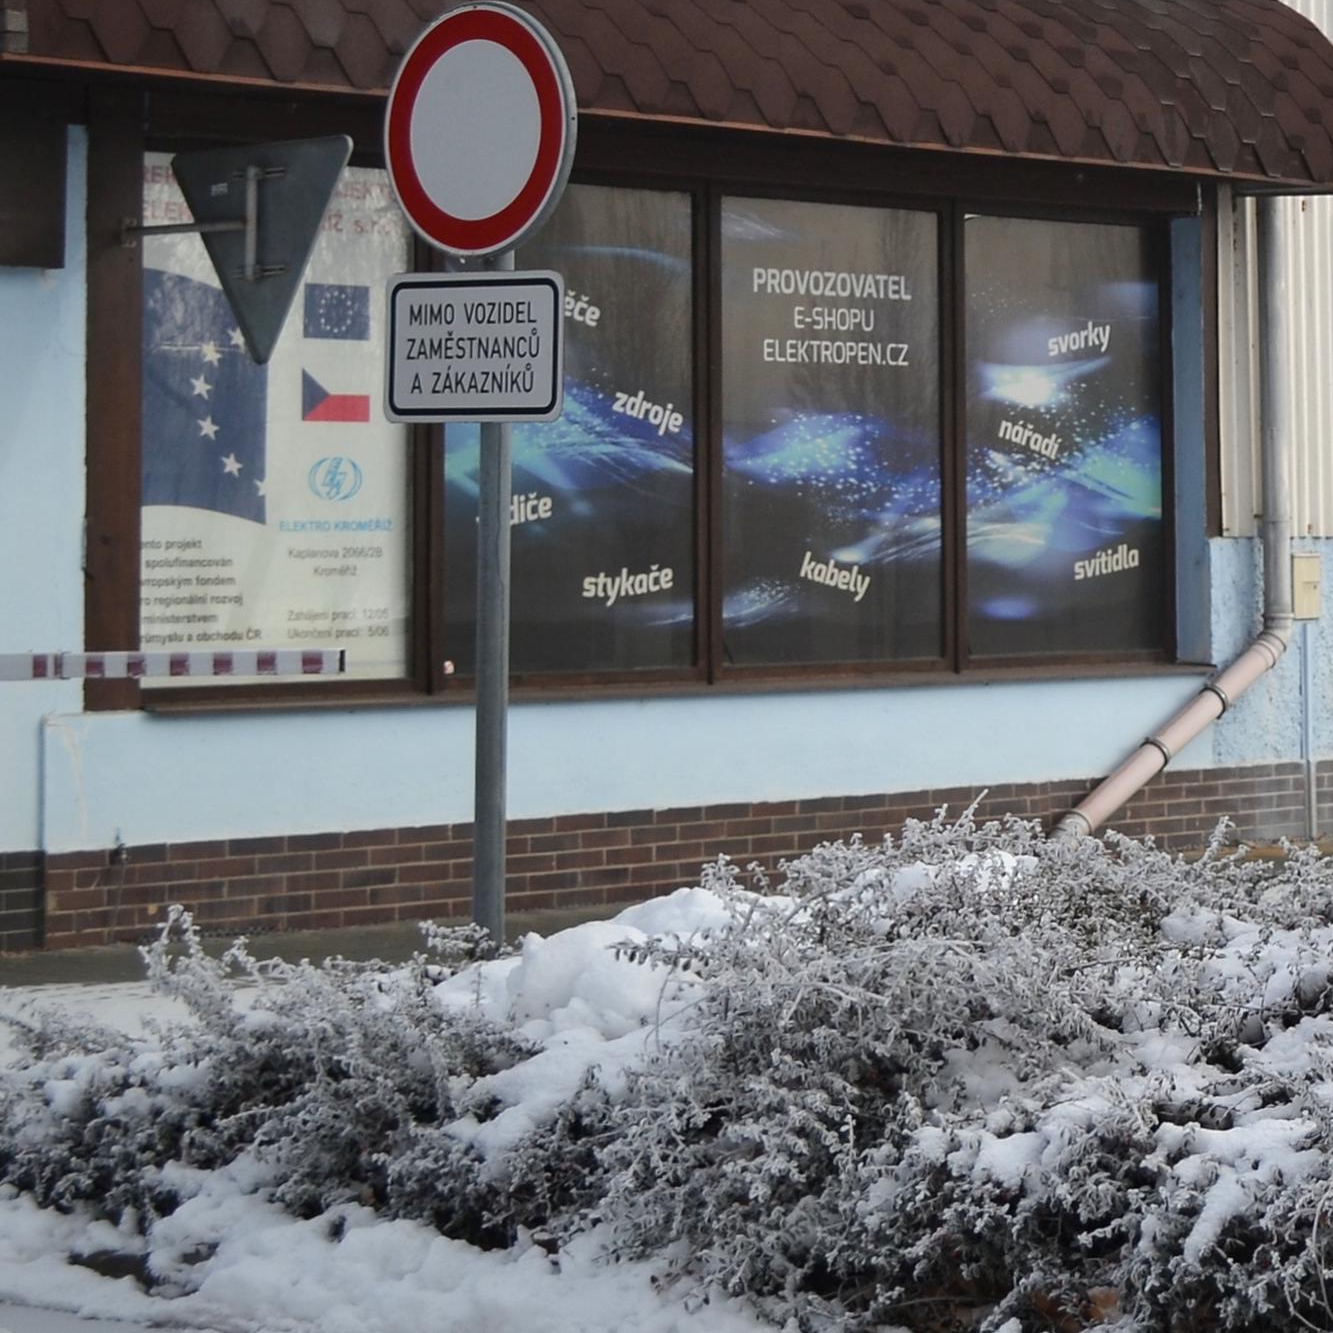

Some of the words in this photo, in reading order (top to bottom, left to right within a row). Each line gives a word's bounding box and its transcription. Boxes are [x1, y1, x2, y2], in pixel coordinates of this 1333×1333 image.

[753, 267, 912, 300] PROVOZOVATEL
[408, 303, 455, 326] MIMO
[464, 301, 537, 325] VOZIDEL
[794, 306, 874, 332] E-SHOPU
[406, 328, 540, 360] ZAMĚSTNANCŮ
[763, 339, 909, 366] ELEKTROPEN.CZ
[1048, 321, 1111, 356] svorky
[411, 373, 423, 394] A
[431, 363, 534, 394] ZÁKAZNÍKŮ
[612, 390, 684, 436] zdroje
[998, 420, 1063, 460] nářadí
[279, 519, 331, 532] ELEKTRO
[165, 538, 202, 552] projekt
[800, 551, 870, 602] kabely
[1074, 544, 1140, 581] svítidla
[196, 575, 236, 586] fondem
[582, 564, 674, 607] stykače
[210, 593, 244, 607] rozvoj
